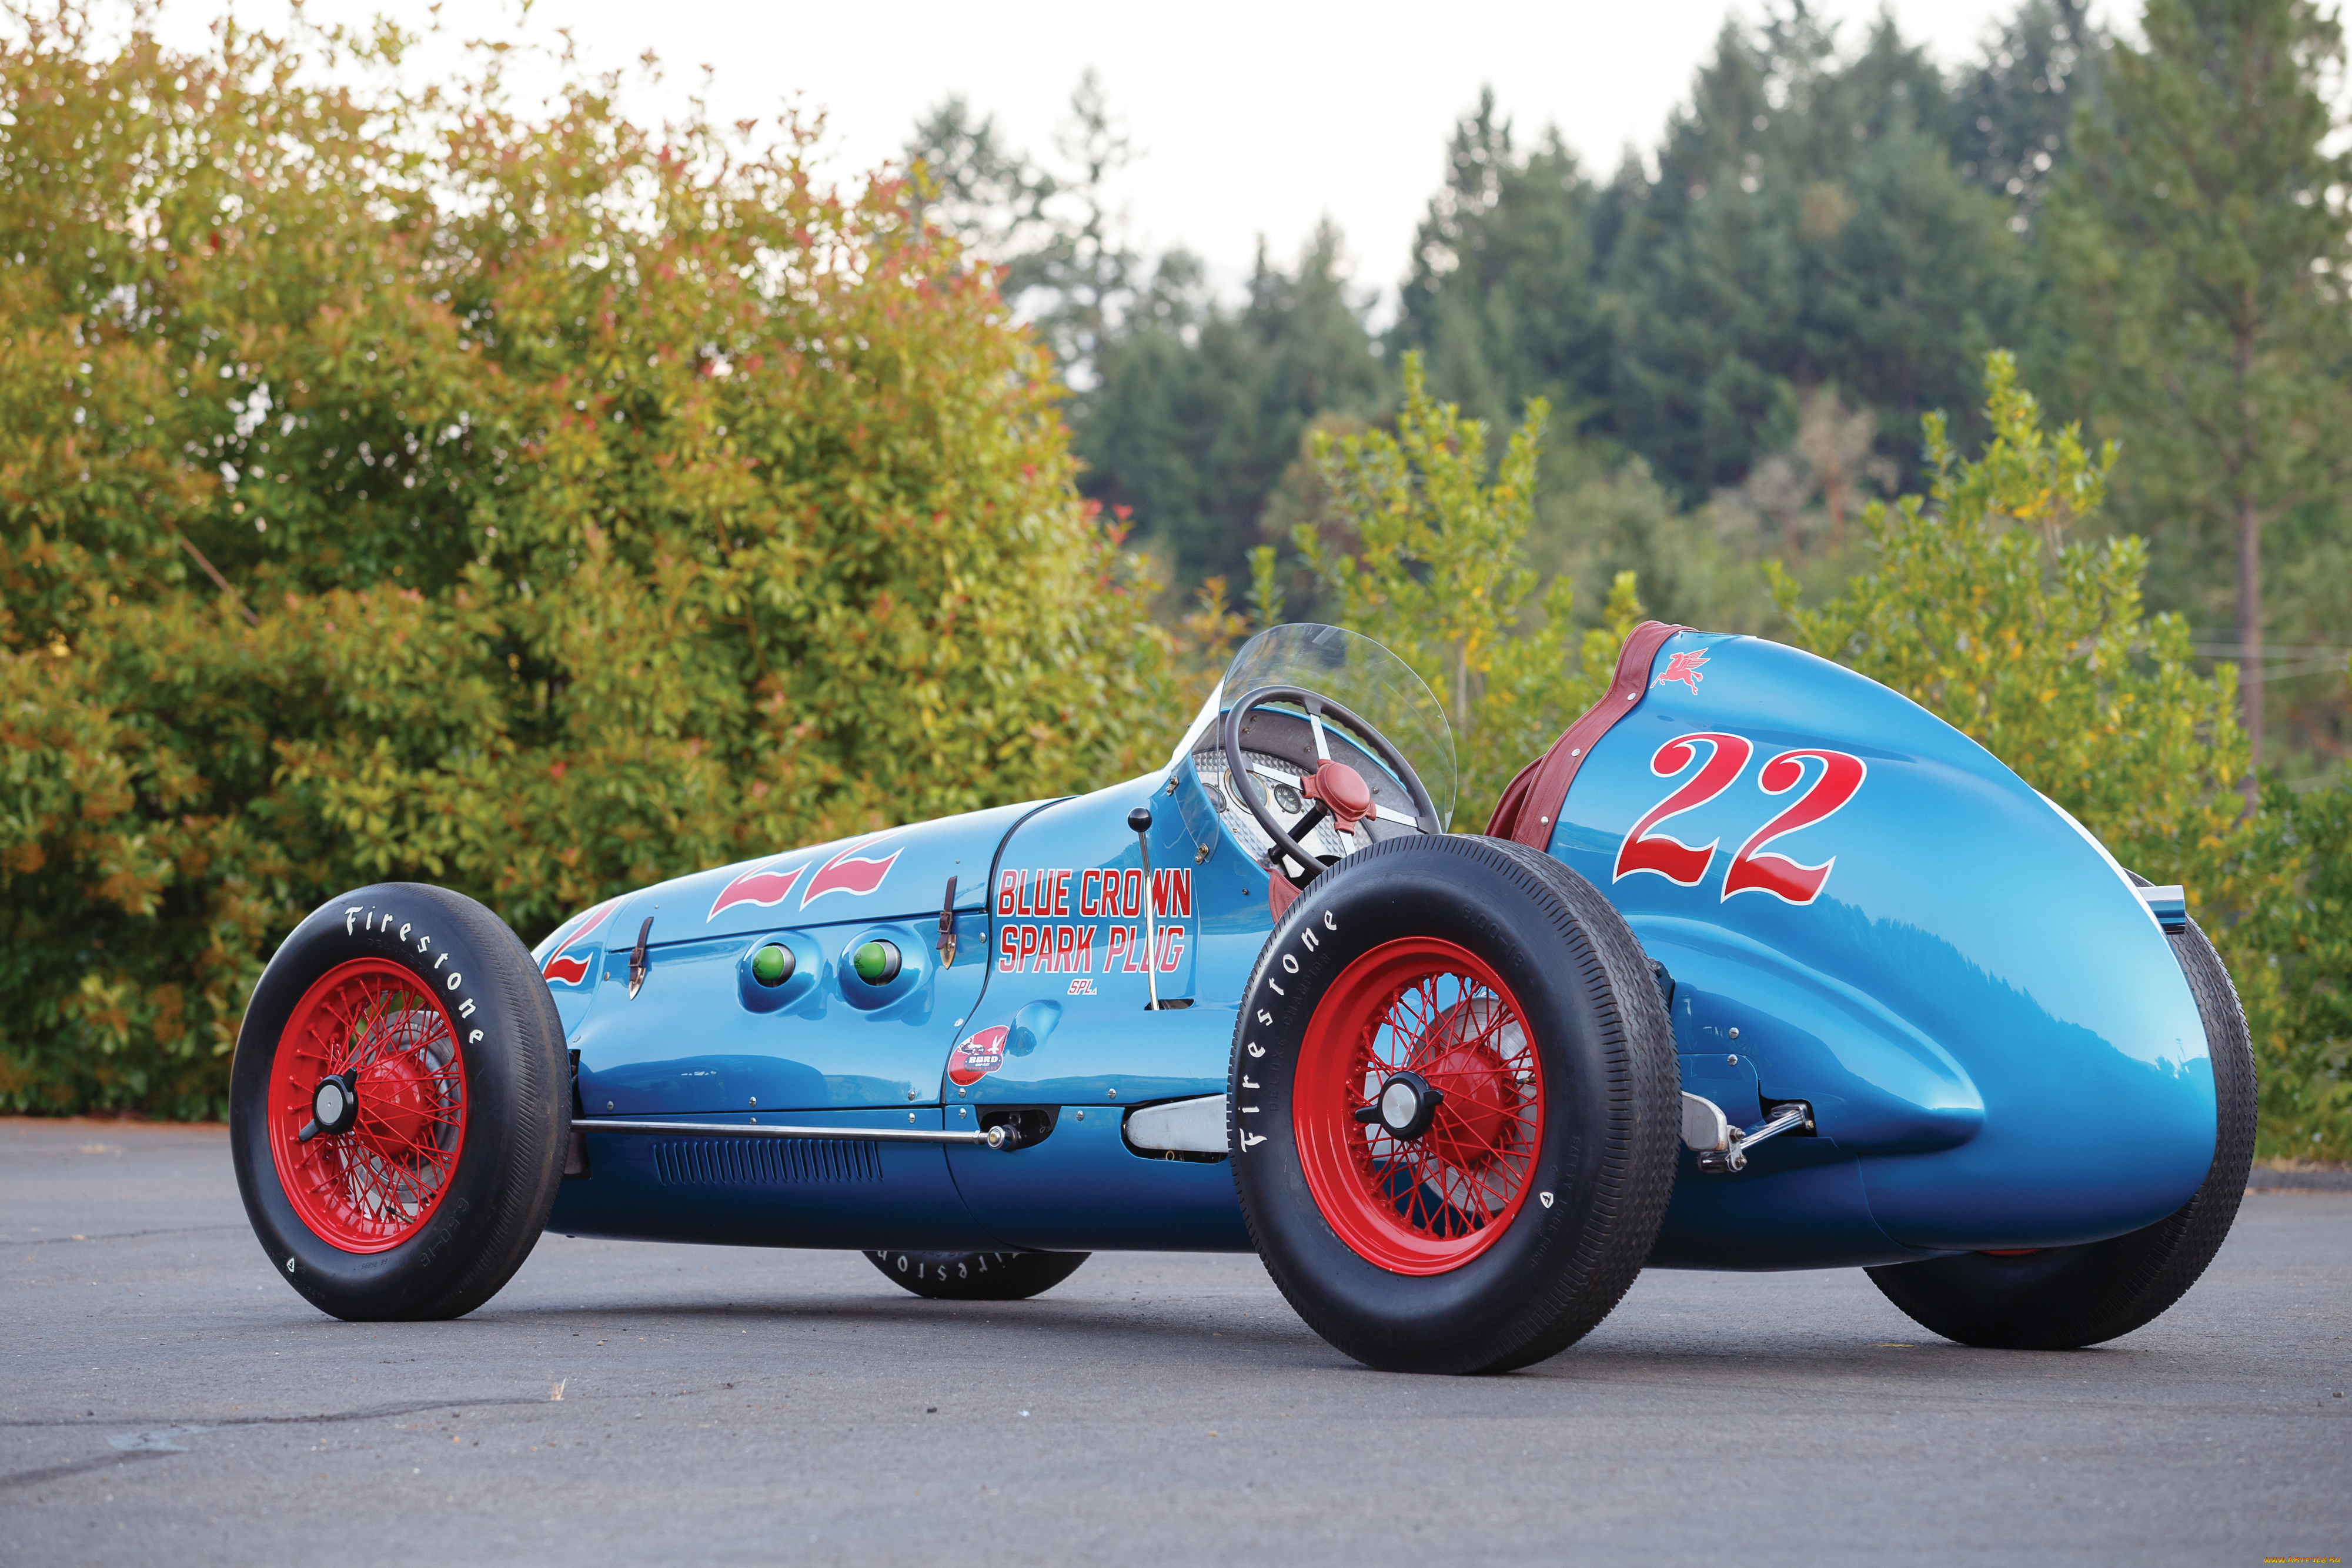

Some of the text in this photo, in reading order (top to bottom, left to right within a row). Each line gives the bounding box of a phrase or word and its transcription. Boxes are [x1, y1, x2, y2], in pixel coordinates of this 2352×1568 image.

[1612, 731, 1867, 905] 22
[997, 868, 1191, 918] BLUE CROWN
[998, 924, 1185, 973] SPARK PLUG
[345, 905, 485, 1044] Firestone
[1239, 910, 1338, 1154] Firestone
